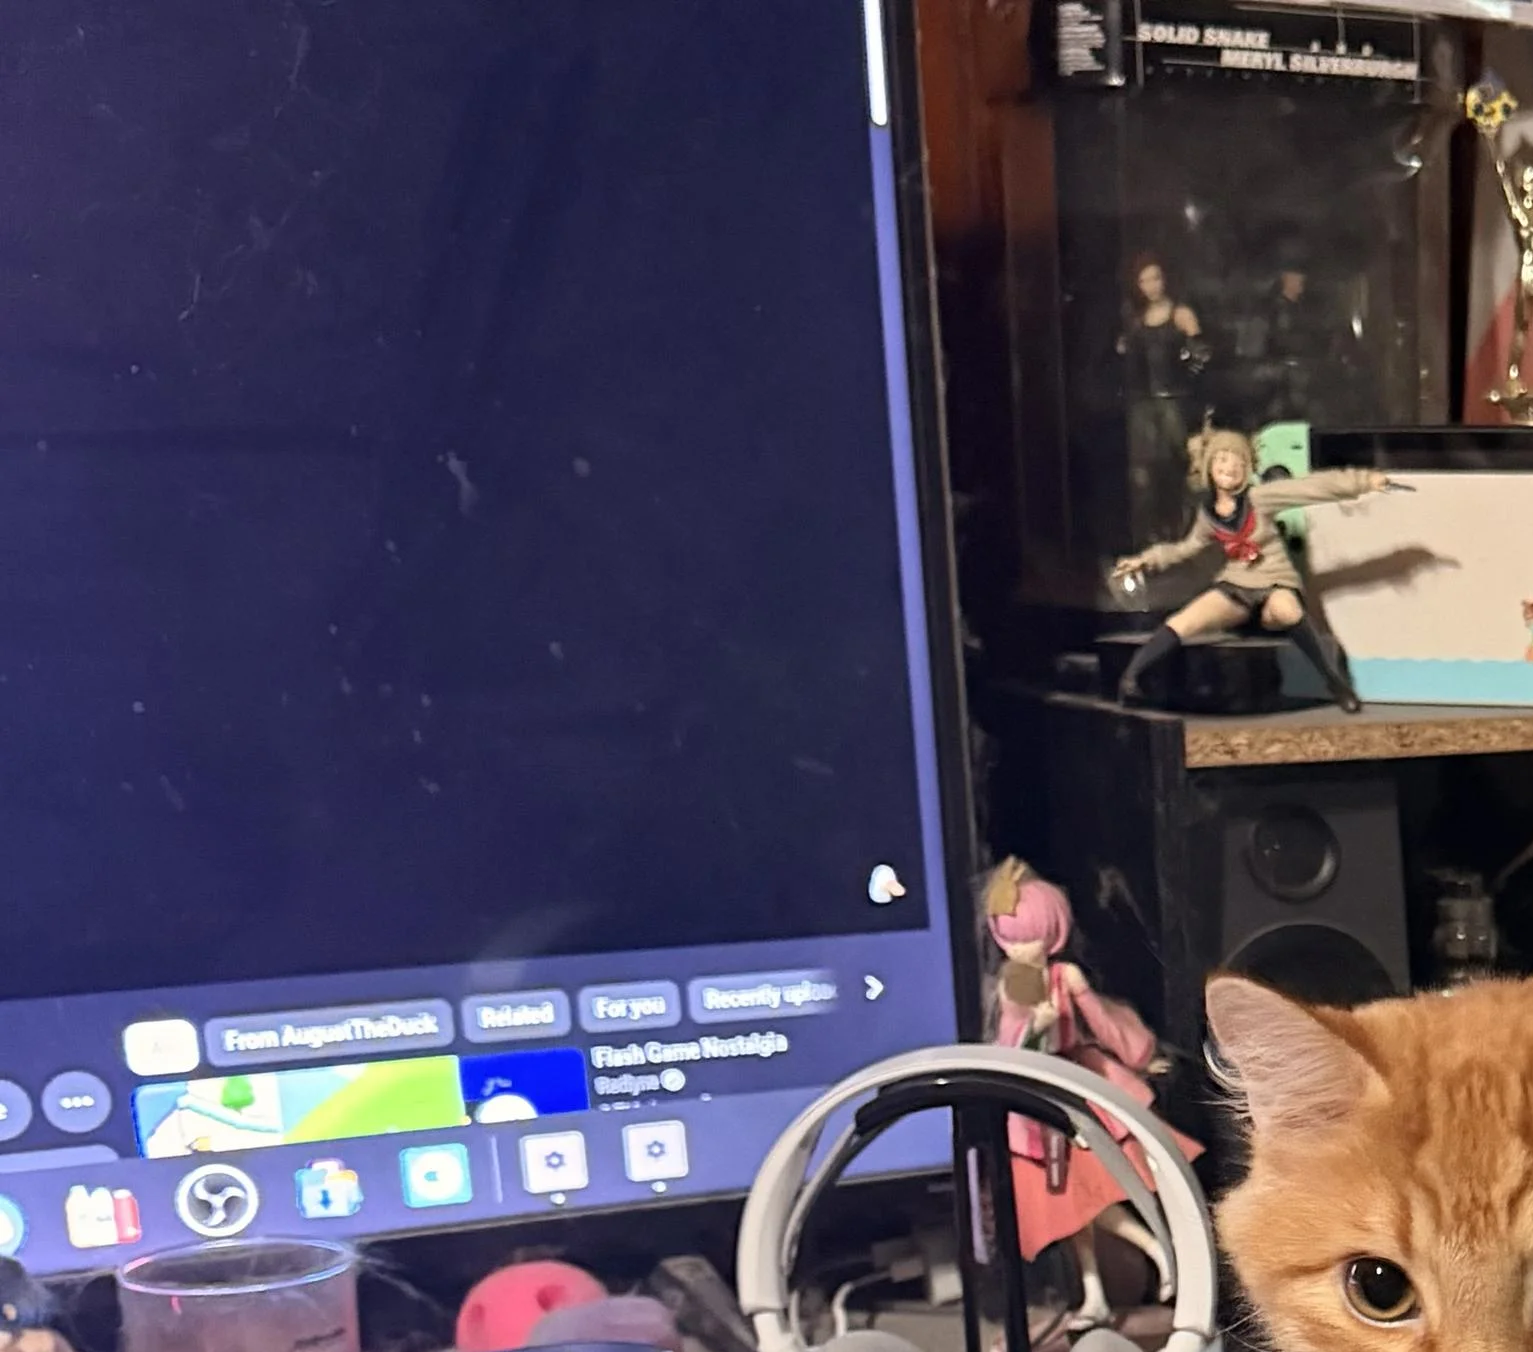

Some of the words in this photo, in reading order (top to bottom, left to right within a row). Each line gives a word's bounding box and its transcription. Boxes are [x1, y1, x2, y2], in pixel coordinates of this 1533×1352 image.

[1137, 23, 1200, 44] SOLID
[1203, 26, 1271, 49] SNAKE
[593, 997, 629, 1019] For
[629, 996, 667, 1020] you
[702, 985, 782, 1010] Recently
[476, 1001, 556, 1029] Related
[222, 1028, 280, 1052] From
[591, 1043, 646, 1068] Flash
[645, 1041, 700, 1064] Game
[700, 1031, 789, 1058] Nostalgia
